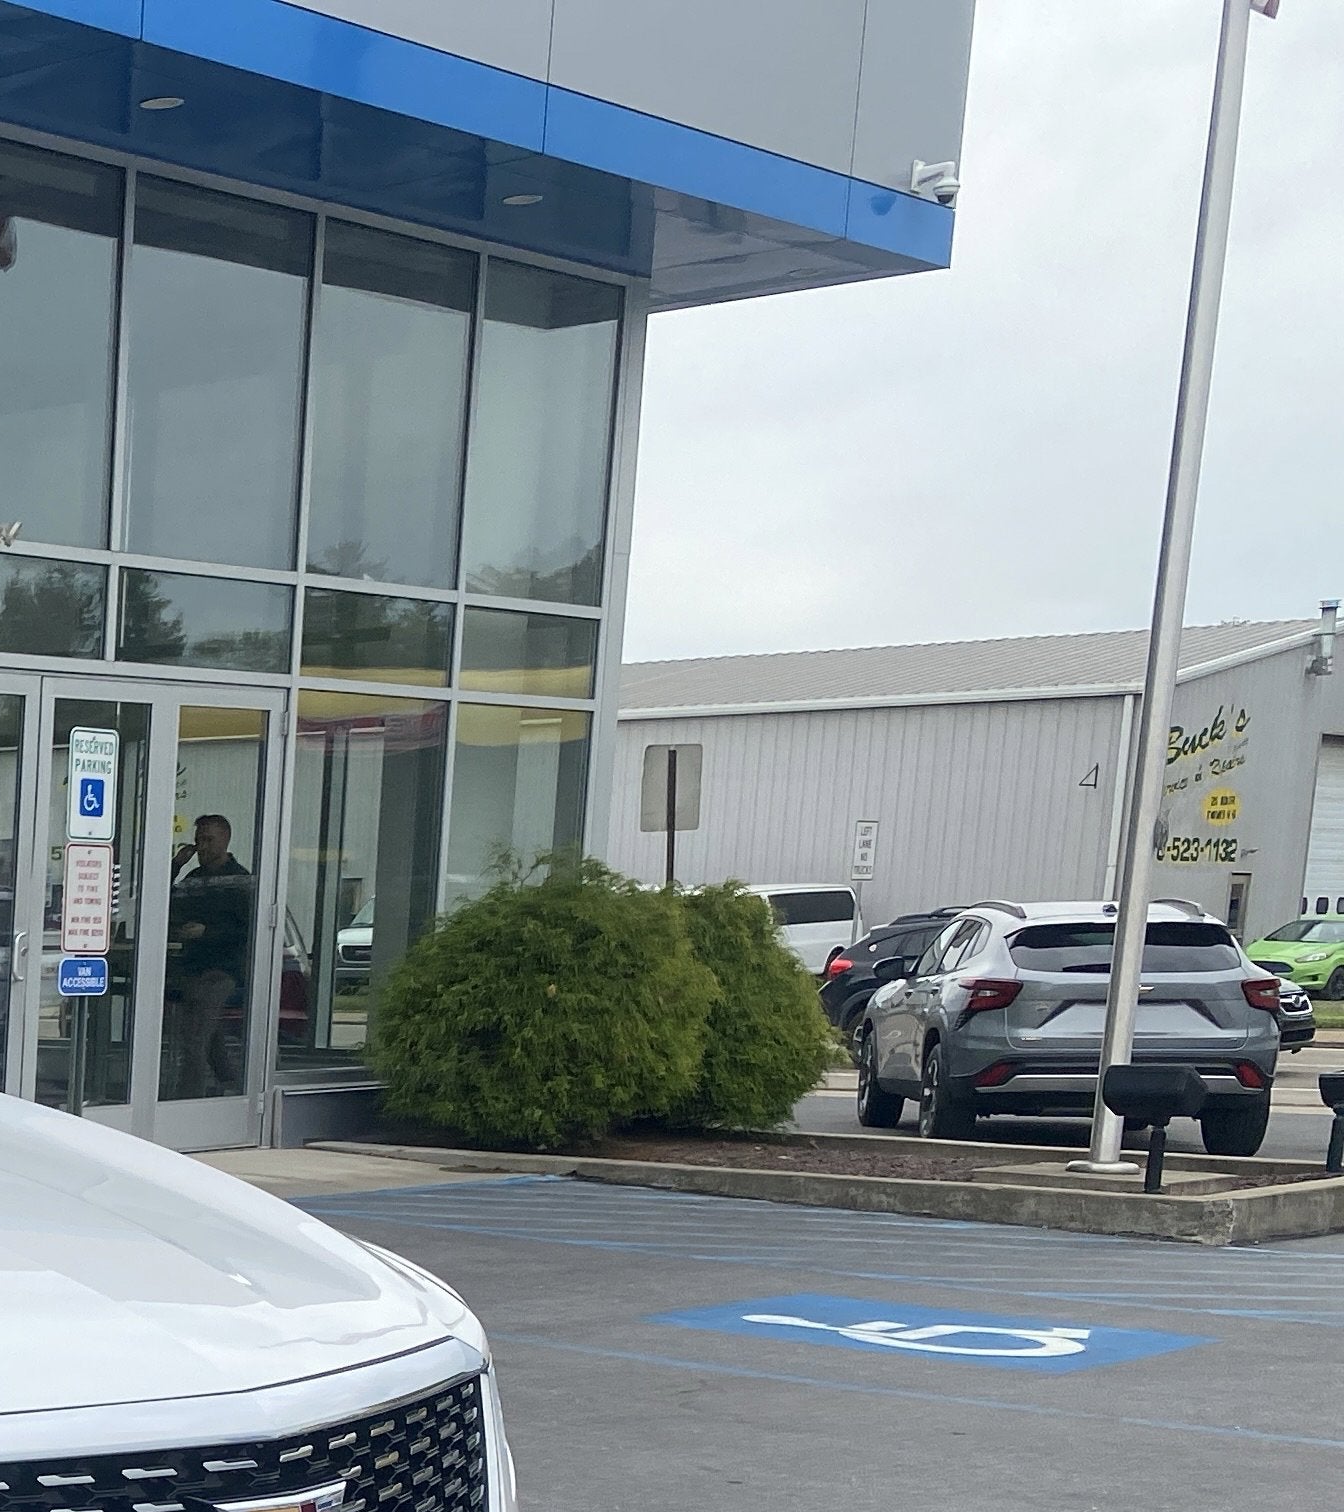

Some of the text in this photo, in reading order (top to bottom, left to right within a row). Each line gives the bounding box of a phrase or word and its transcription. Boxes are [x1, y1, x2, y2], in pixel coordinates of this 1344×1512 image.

[1166, 703, 1252, 766] Buck's
[74, 738, 114, 756] RESERVED
[74, 758, 113, 774] PARKING
[860, 825, 873, 837] LEFT
[858, 839, 873, 849] LANE
[860, 852, 868, 862] NO
[75, 860, 103, 869] VIOLATORS
[853, 865, 873, 875] TRUCKS
[77, 872, 100, 881] SUBJECT
[77, 885, 85, 893] TO
[77, 966, 92, 977] VAN
[61, 976, 105, 988] ACCESSIBLE
